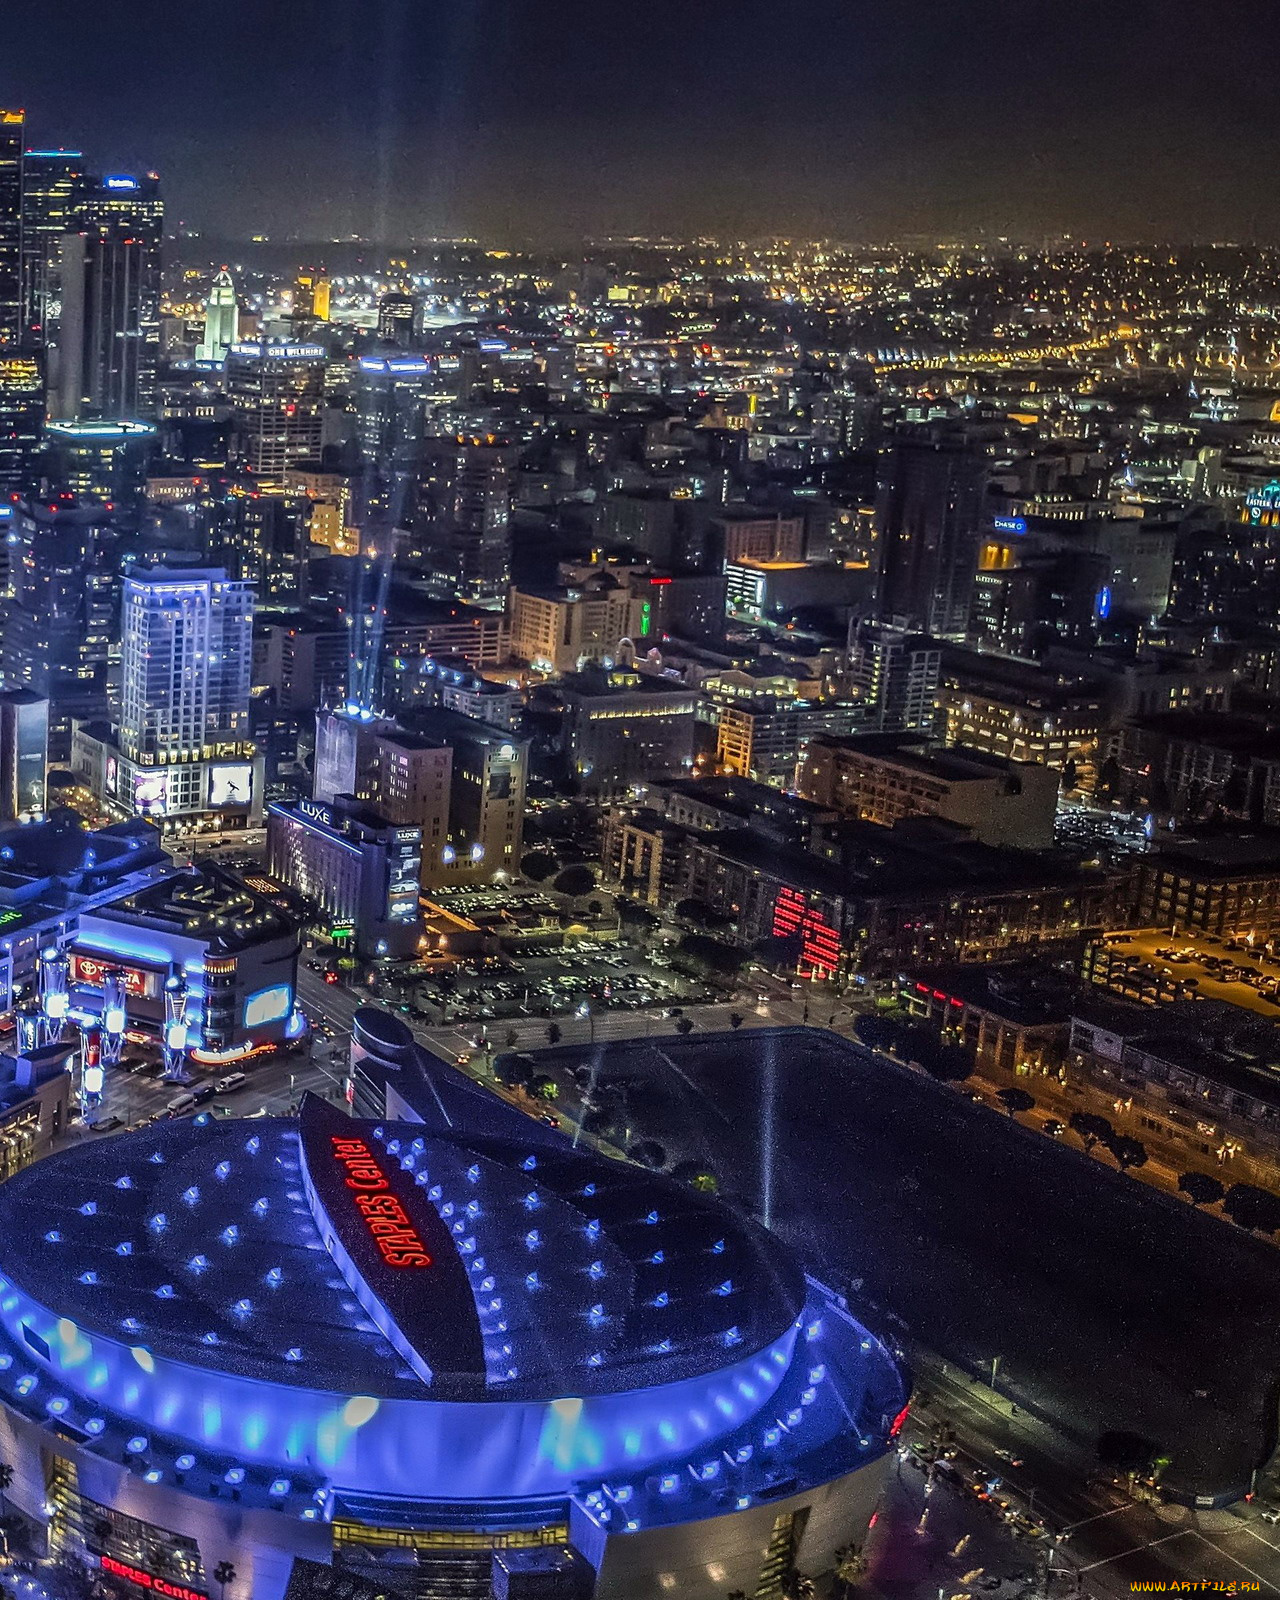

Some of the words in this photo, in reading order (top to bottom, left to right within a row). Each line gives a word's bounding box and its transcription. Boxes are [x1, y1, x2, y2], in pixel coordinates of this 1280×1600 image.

[994, 520, 1016, 529] CHASE
[300, 801, 331, 825] LUXE
[397, 831, 419, 839] LUXE
[333, 918, 355, 926] LUXE
[331, 1137, 389, 1189] Center
[355, 1195, 431, 1266] STAPLES
[101, 1556, 152, 1587] STAPLES
